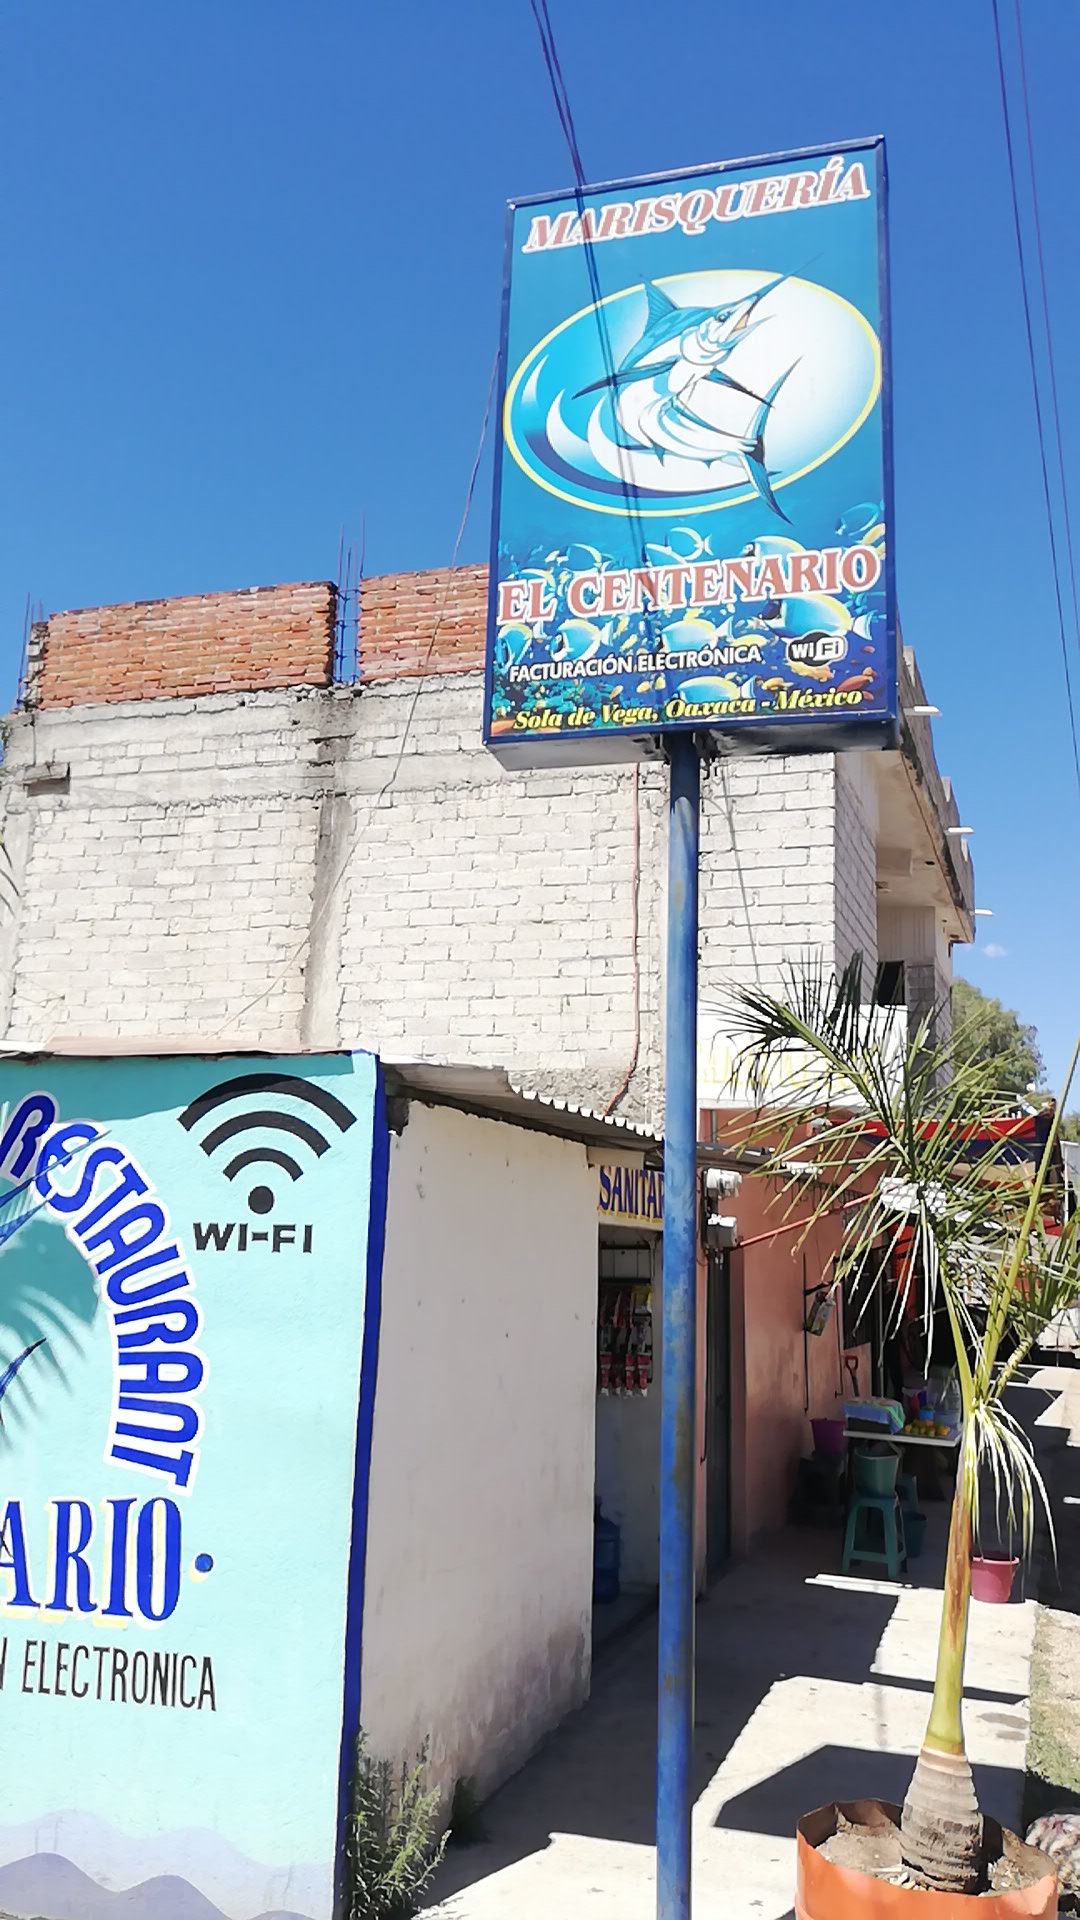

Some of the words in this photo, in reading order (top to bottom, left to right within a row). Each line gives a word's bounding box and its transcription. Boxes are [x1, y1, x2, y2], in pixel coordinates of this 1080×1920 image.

[523, 156, 870, 253] MARISQUERÍA
[499, 581, 555, 624] EL
[570, 547, 880, 618] CENTENARIO
[509, 655, 633, 682] FACTURACIÓN
[637, 645, 762, 672] ELECTRÓNICA
[513, 711, 561, 730] Sola
[567, 707, 595, 727] de
[602, 703, 658, 726] Vega,
[665, 697, 757, 718] Oaxaca
[774, 688, 863, 711] México
[193, 1222, 313, 1254] WI-FI
[22, 1639, 217, 1712] ELECTRONICA
